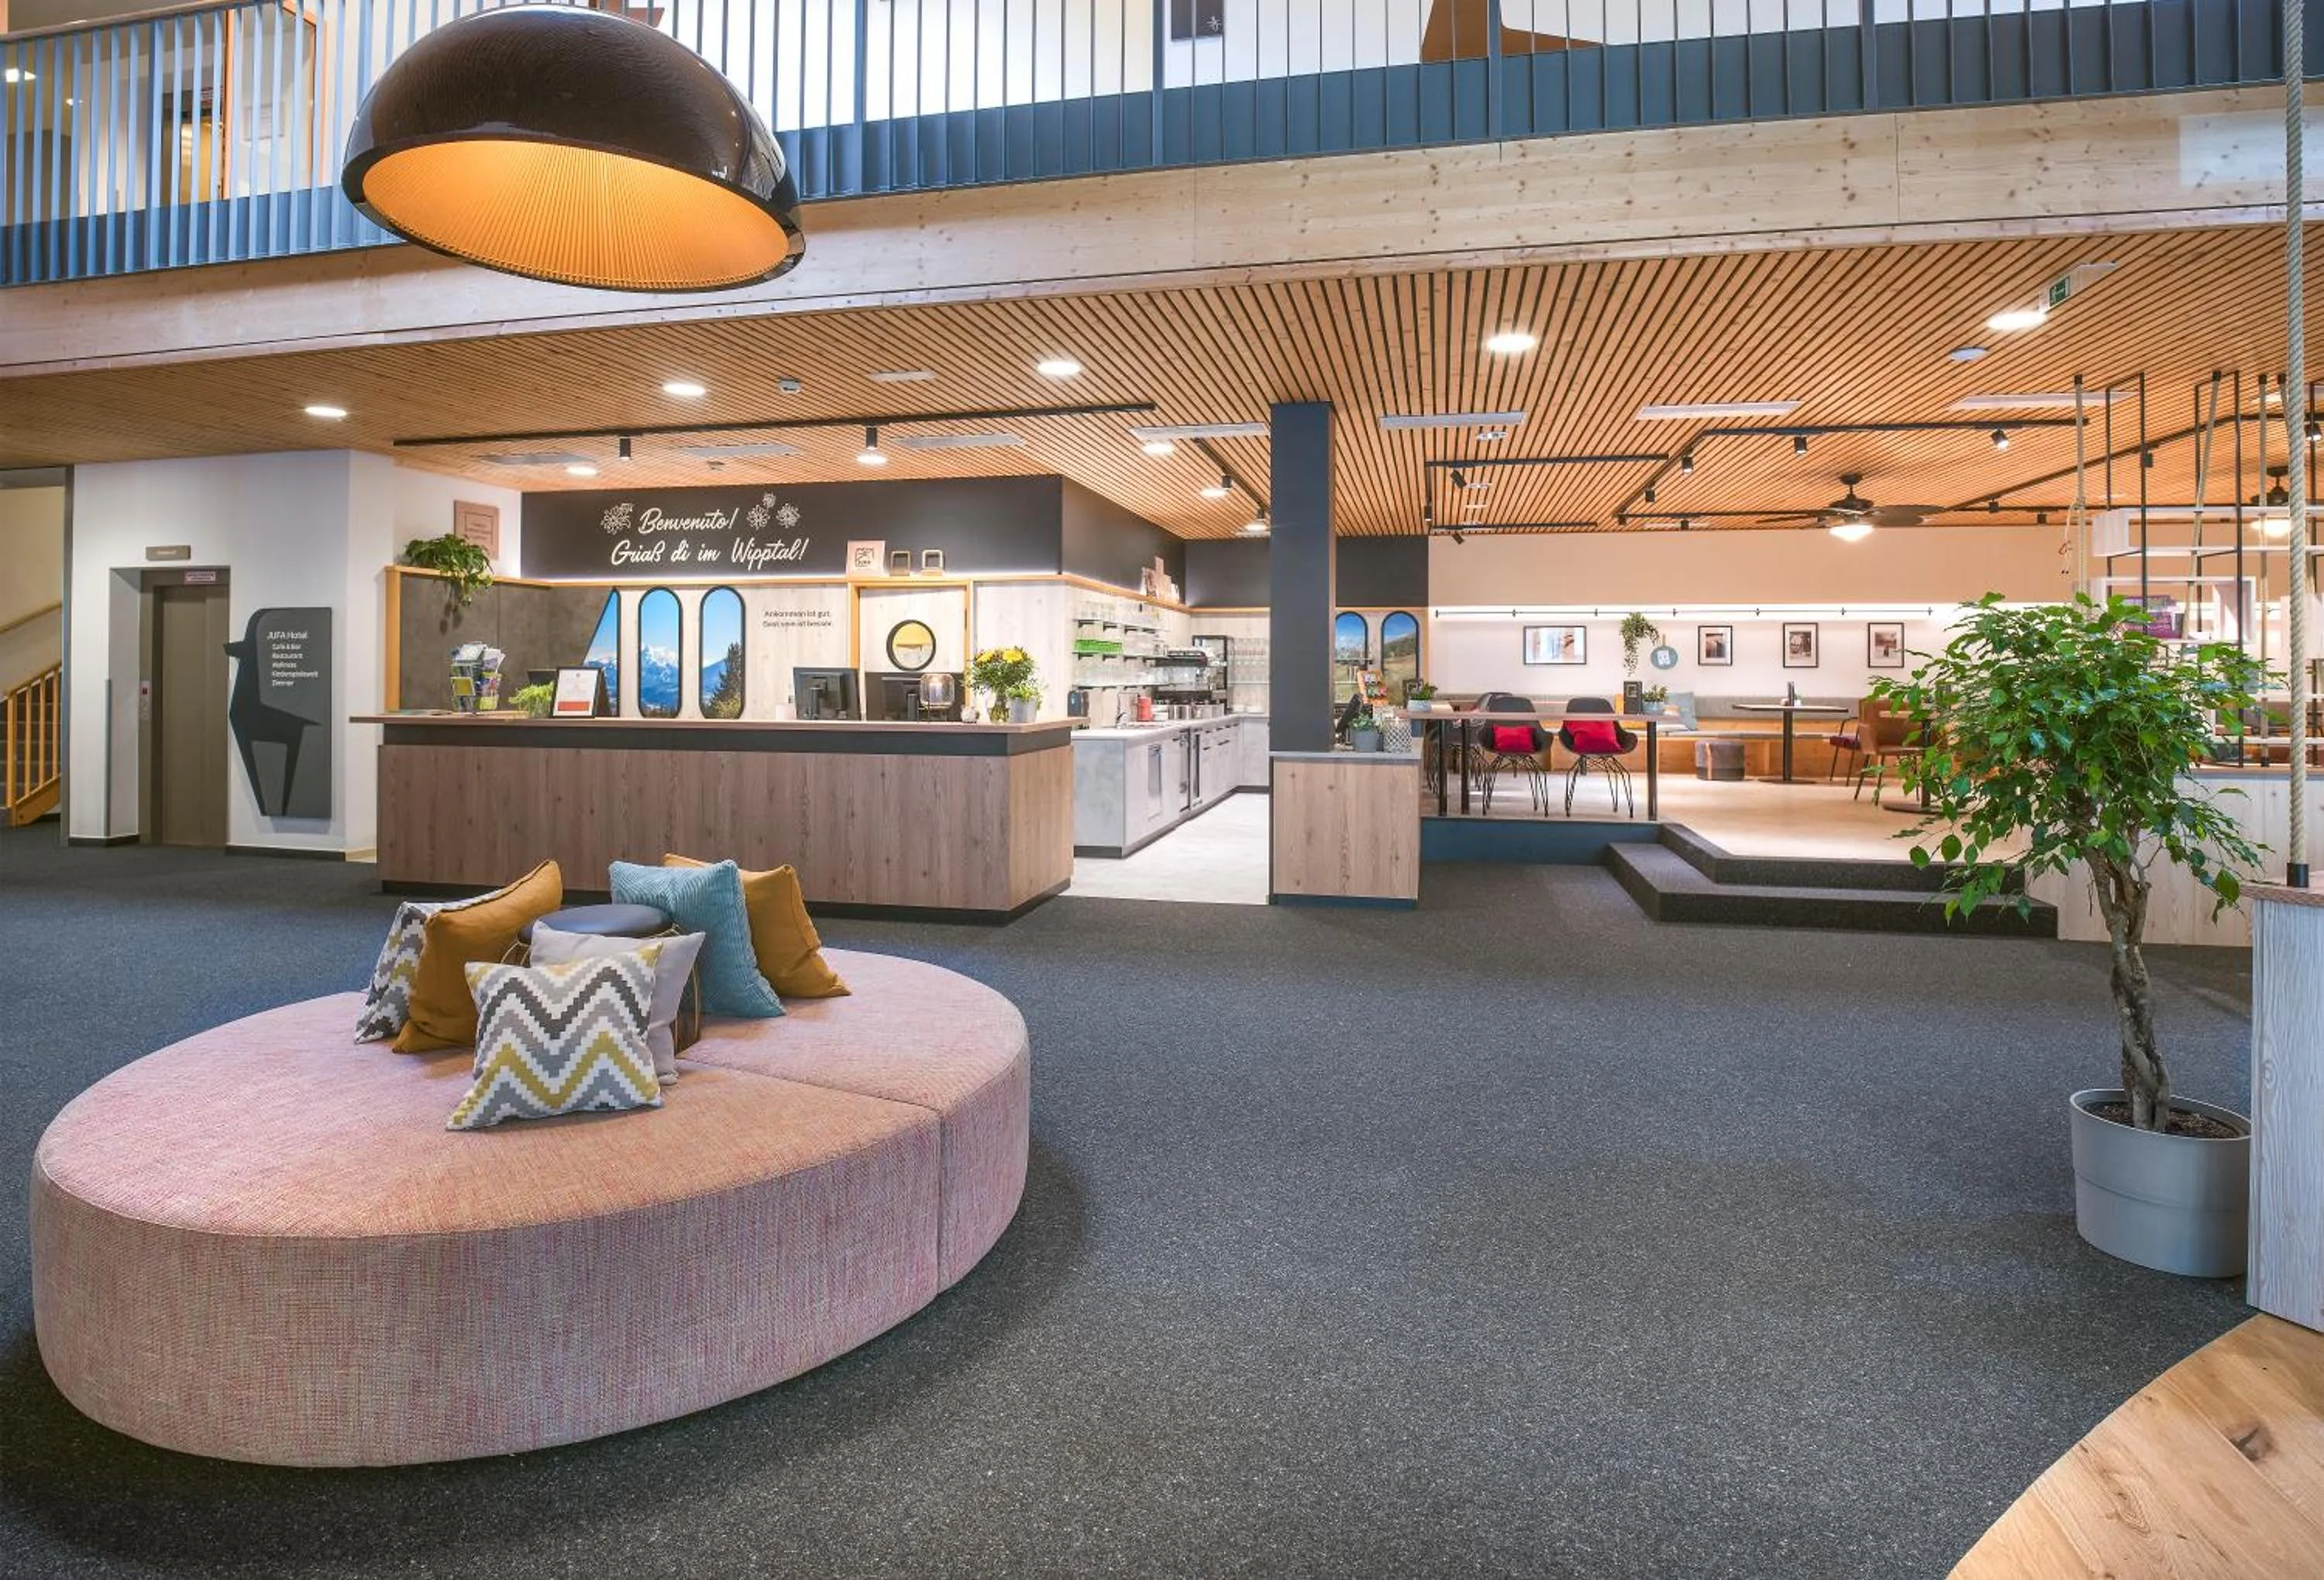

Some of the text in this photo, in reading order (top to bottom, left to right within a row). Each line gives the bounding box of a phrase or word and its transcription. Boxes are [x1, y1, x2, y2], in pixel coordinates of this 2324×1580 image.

[638, 507, 740, 534] Benvenuto!
[610, 537, 810, 571] Griaß di im Wipptal!
[266, 630, 308, 640] JUFA Hotel
